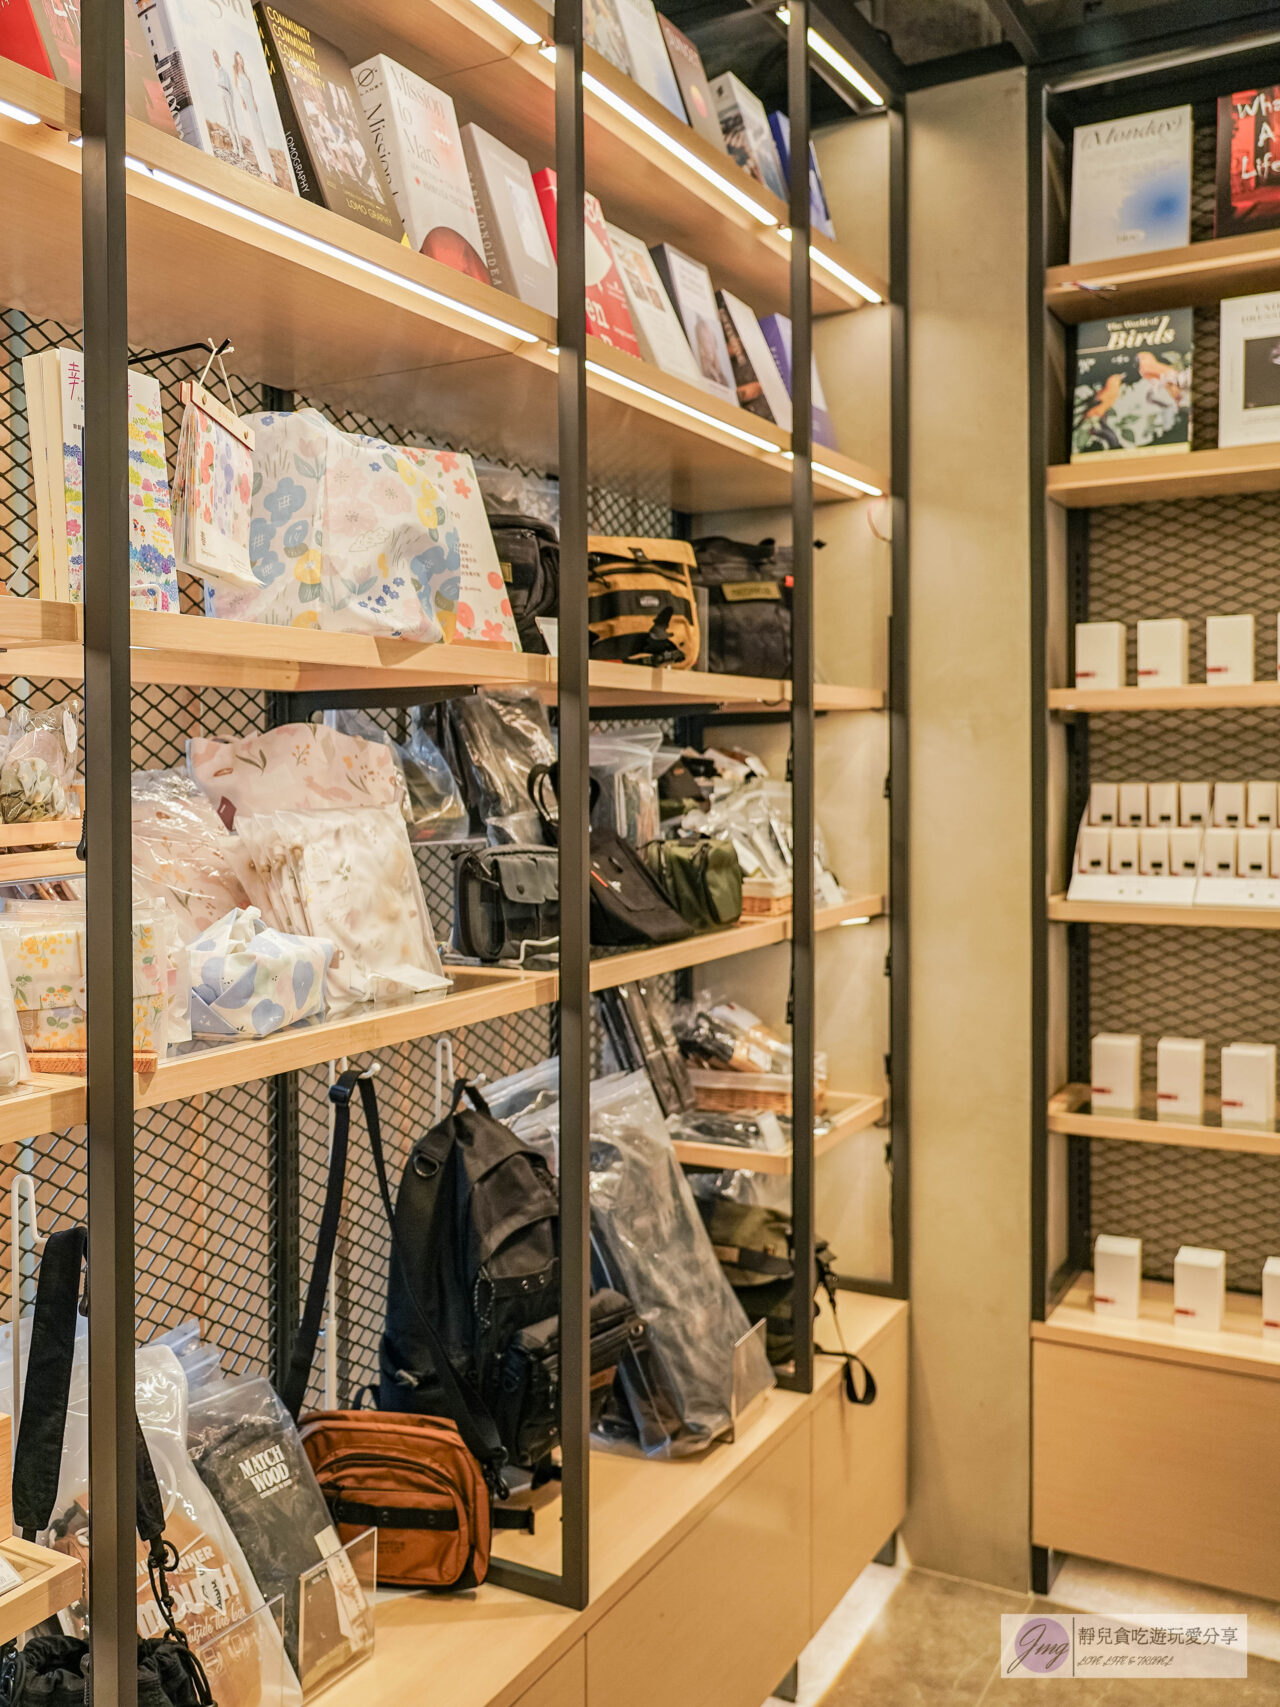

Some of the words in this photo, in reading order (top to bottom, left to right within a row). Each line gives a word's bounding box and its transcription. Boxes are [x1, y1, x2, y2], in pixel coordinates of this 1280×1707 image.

[266, 6, 311, 43] COMMUNITY
[272, 23, 316, 60] COMMUNITY
[1257, 122, 1277, 148] A
[285, 131, 311, 193] LOMOGRAPHY
[1106, 315, 1176, 351] Birds
[238, 1444, 285, 1480] MATCH
[250, 1463, 290, 1494] WOOD
